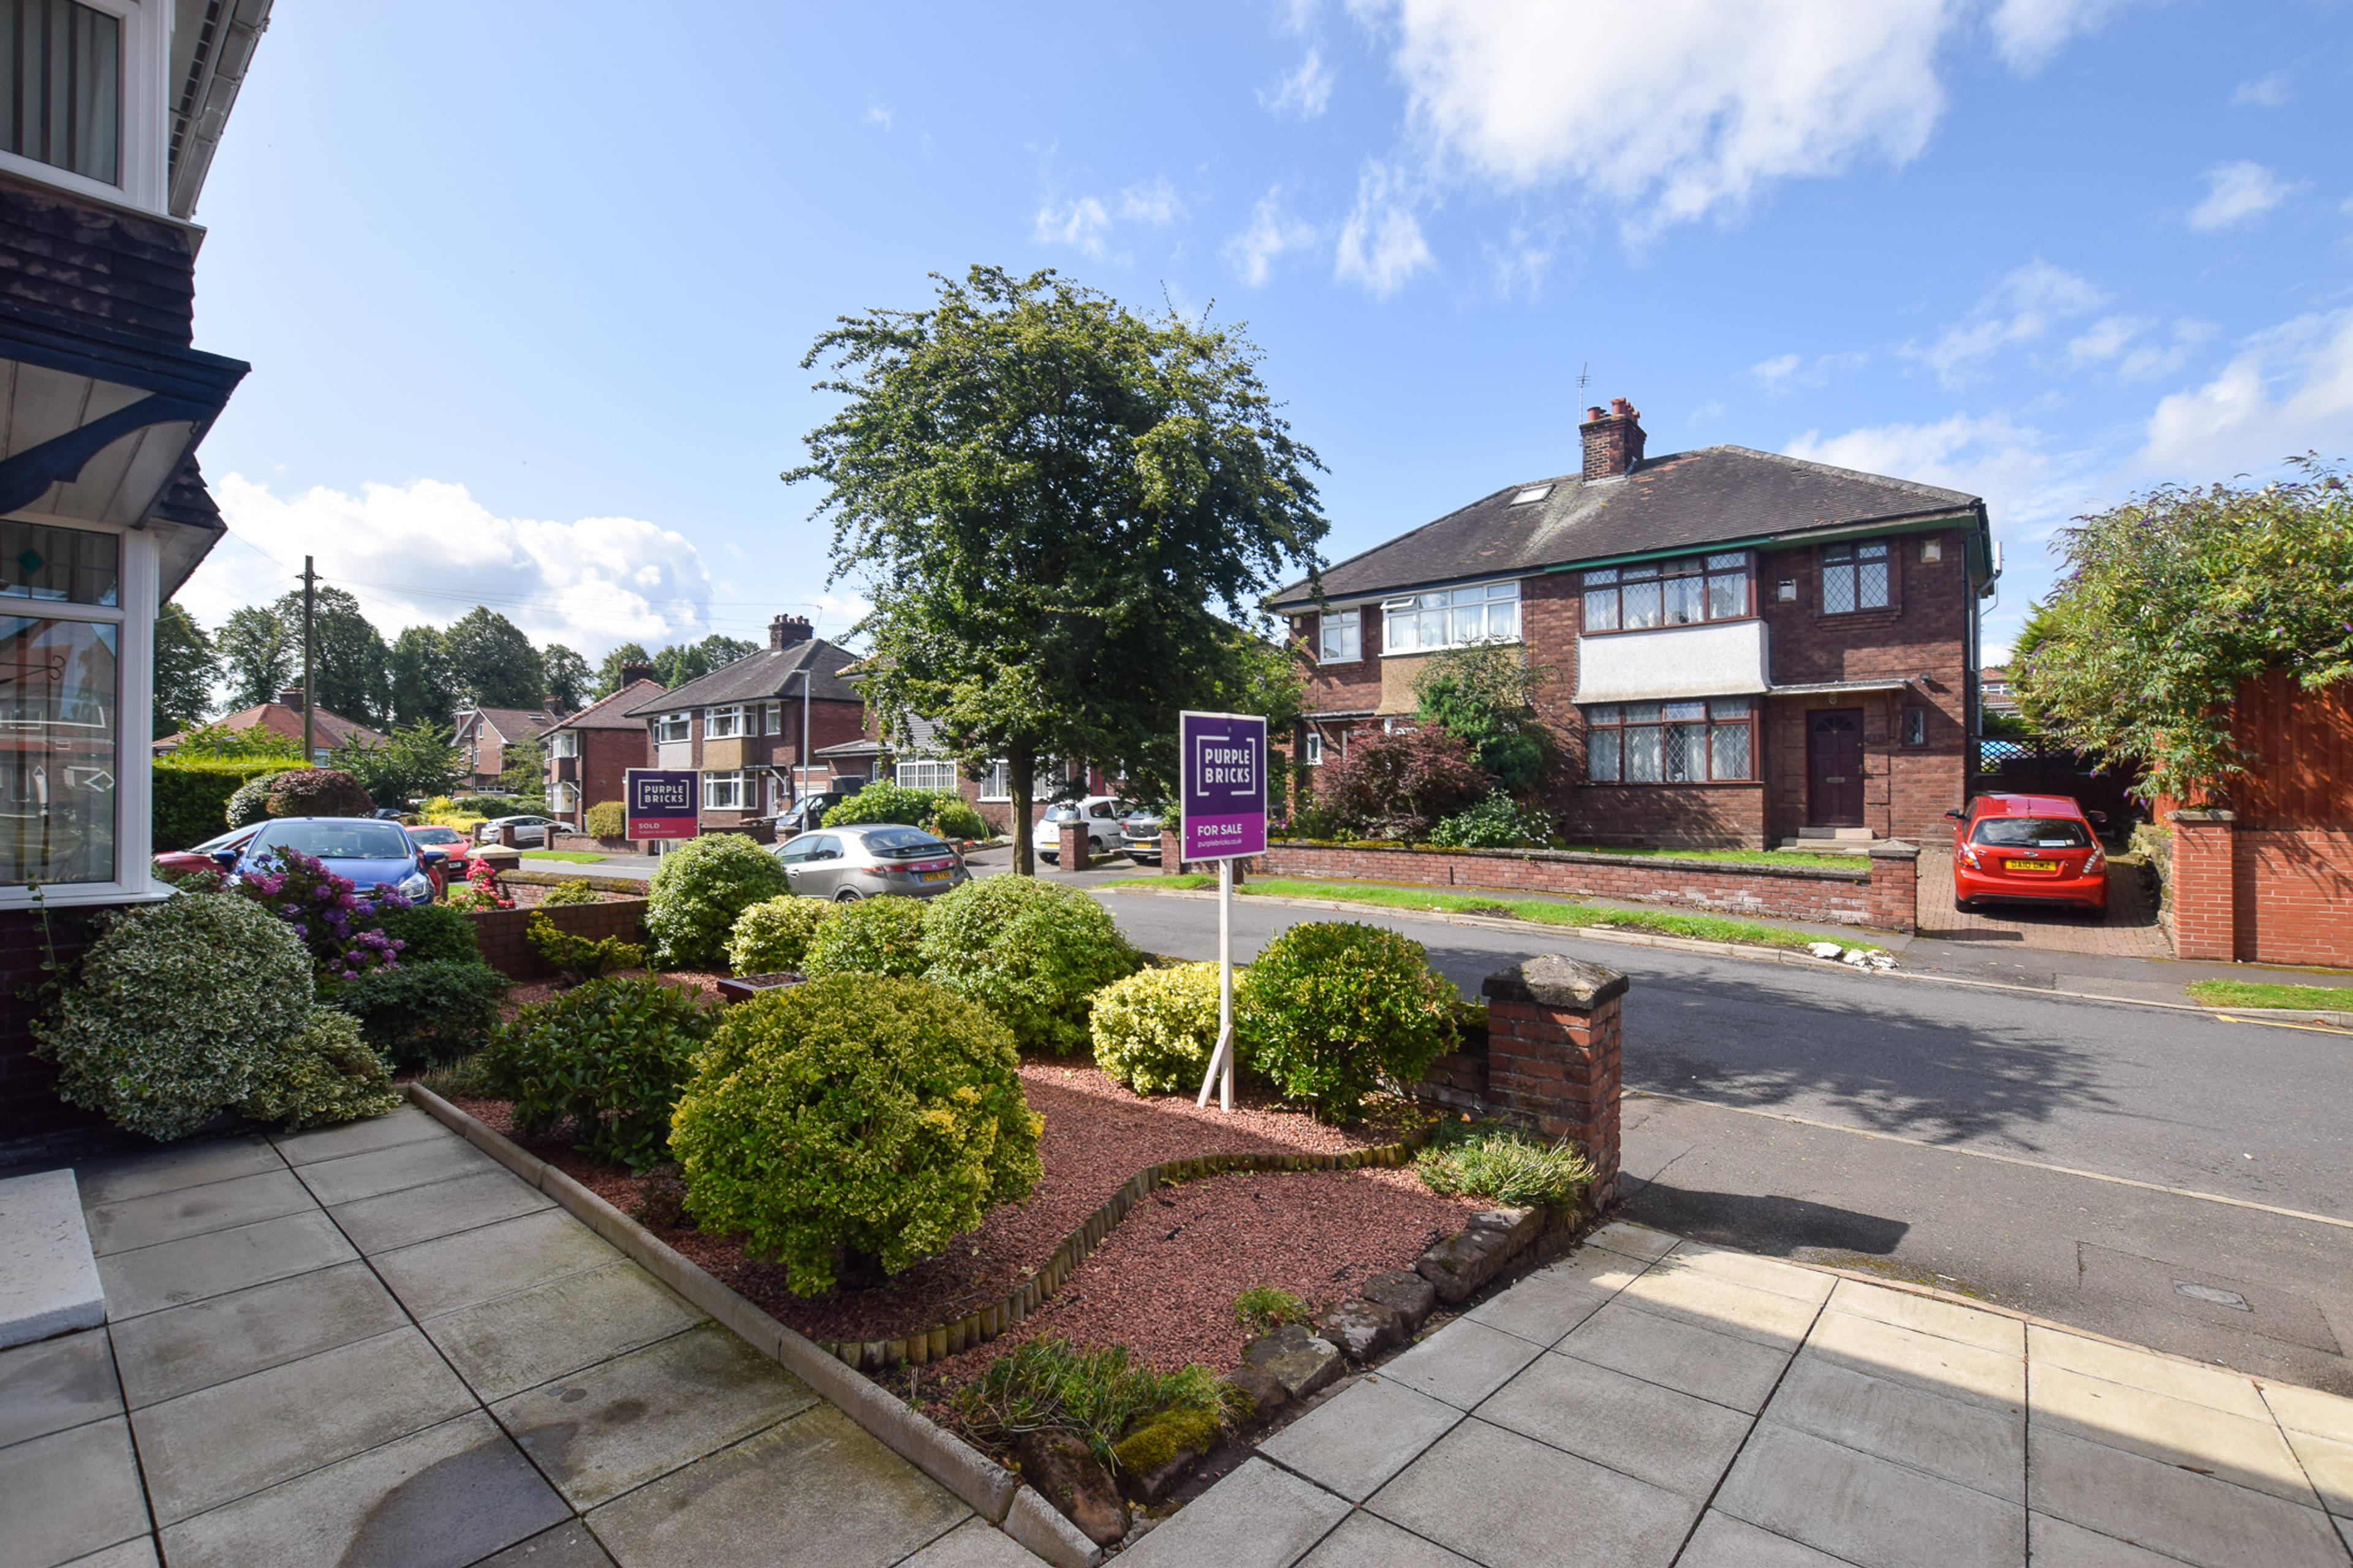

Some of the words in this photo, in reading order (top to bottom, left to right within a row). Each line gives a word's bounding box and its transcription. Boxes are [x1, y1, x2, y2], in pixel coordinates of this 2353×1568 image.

[1205, 748, 1250, 764] PURPLE
[1205, 768, 1250, 783] BRICKS
[1197, 825, 1218, 836] FOR
[1221, 824, 1242, 835] SALE
